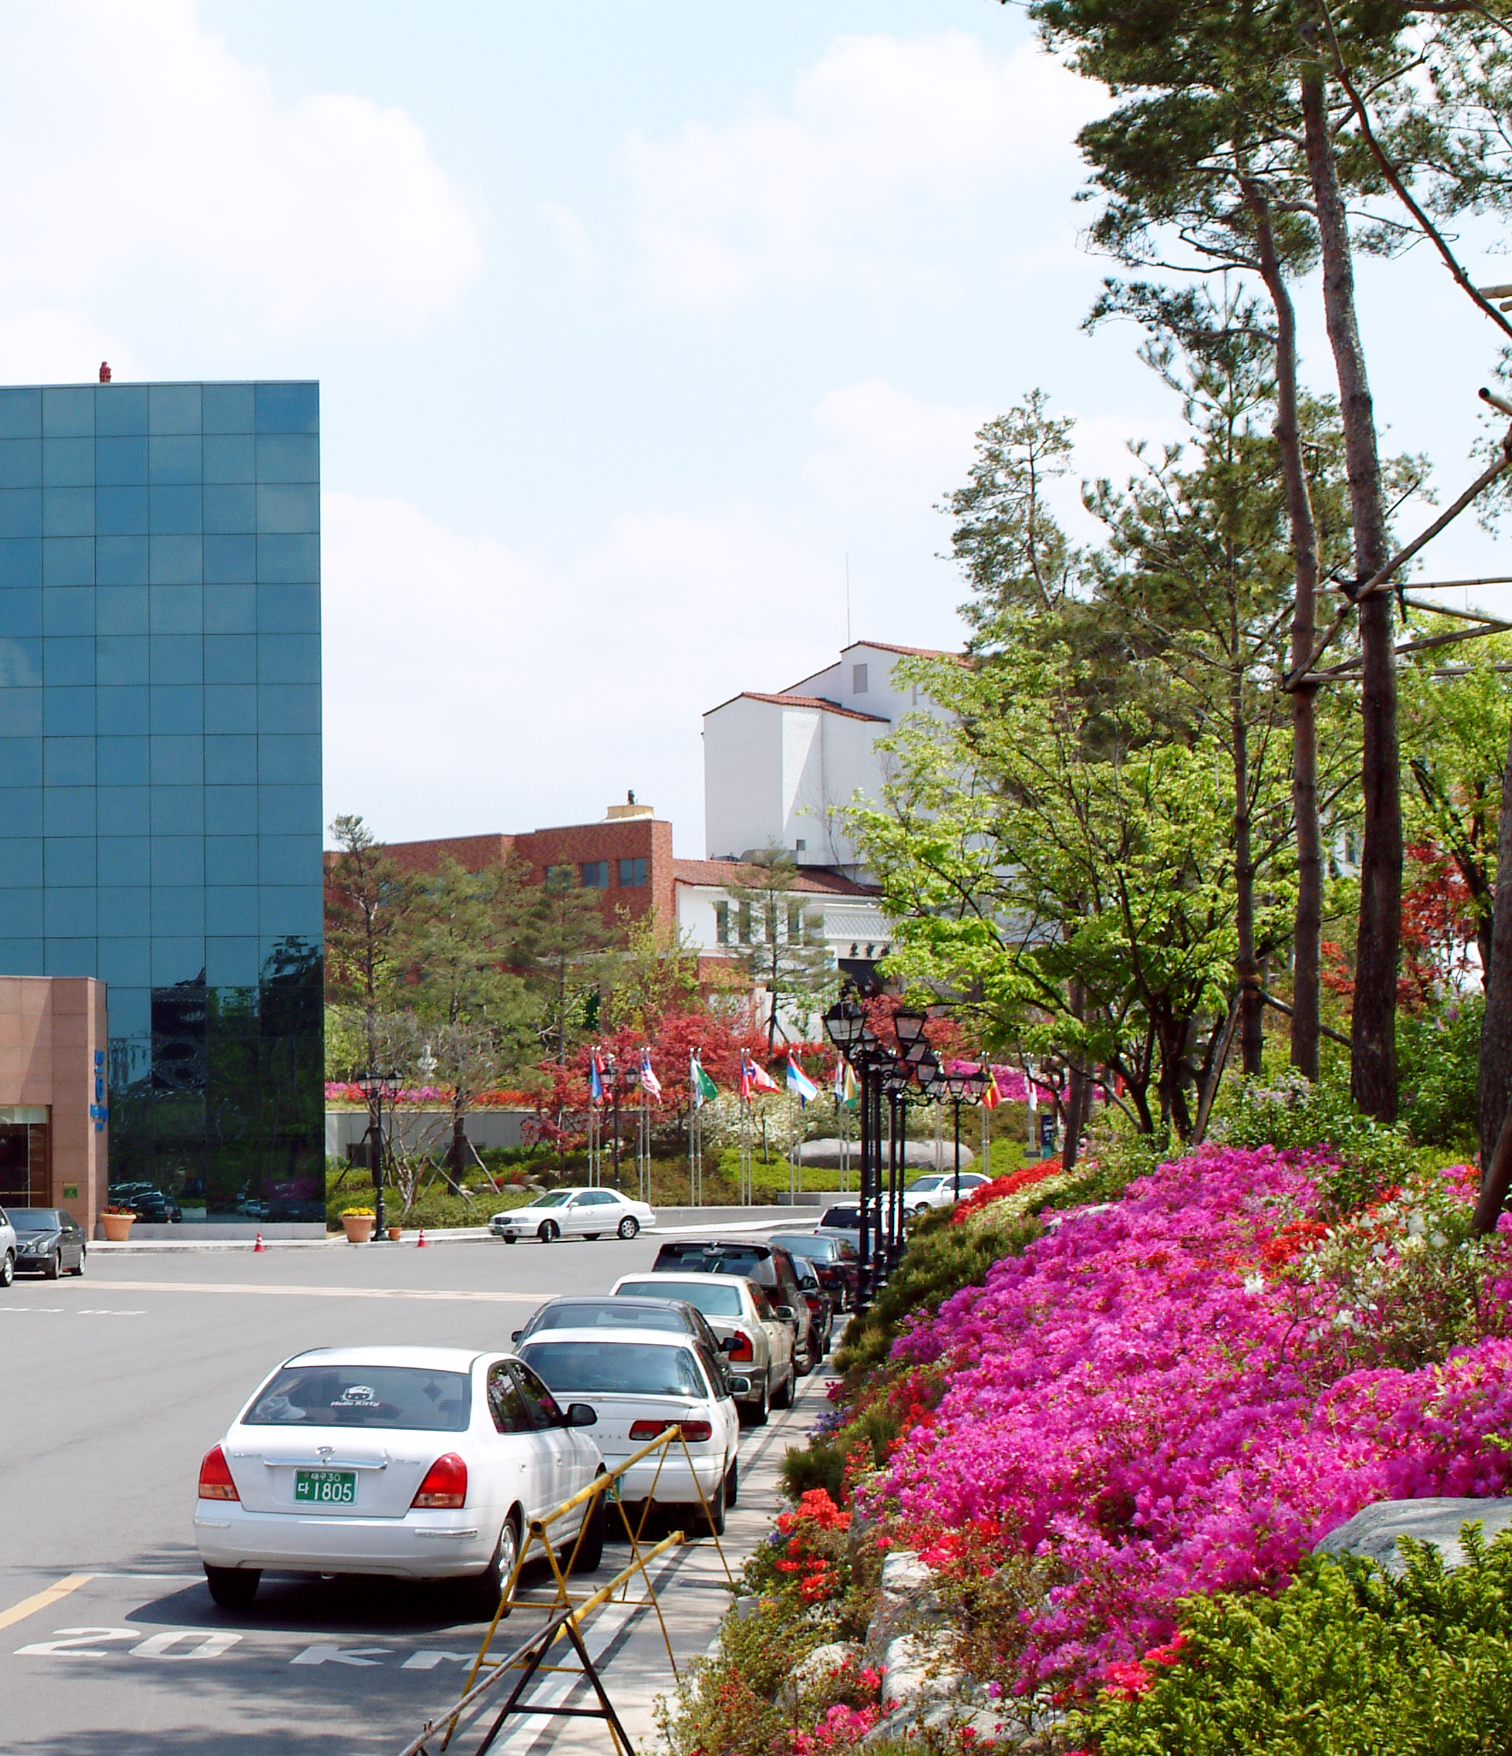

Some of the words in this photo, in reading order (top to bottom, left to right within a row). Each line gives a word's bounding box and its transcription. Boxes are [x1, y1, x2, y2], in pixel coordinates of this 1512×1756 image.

[310, 1472, 341, 1482] 대구30
[314, 1482, 353, 1502] 1805
[13, 1627, 243, 1660] 20
